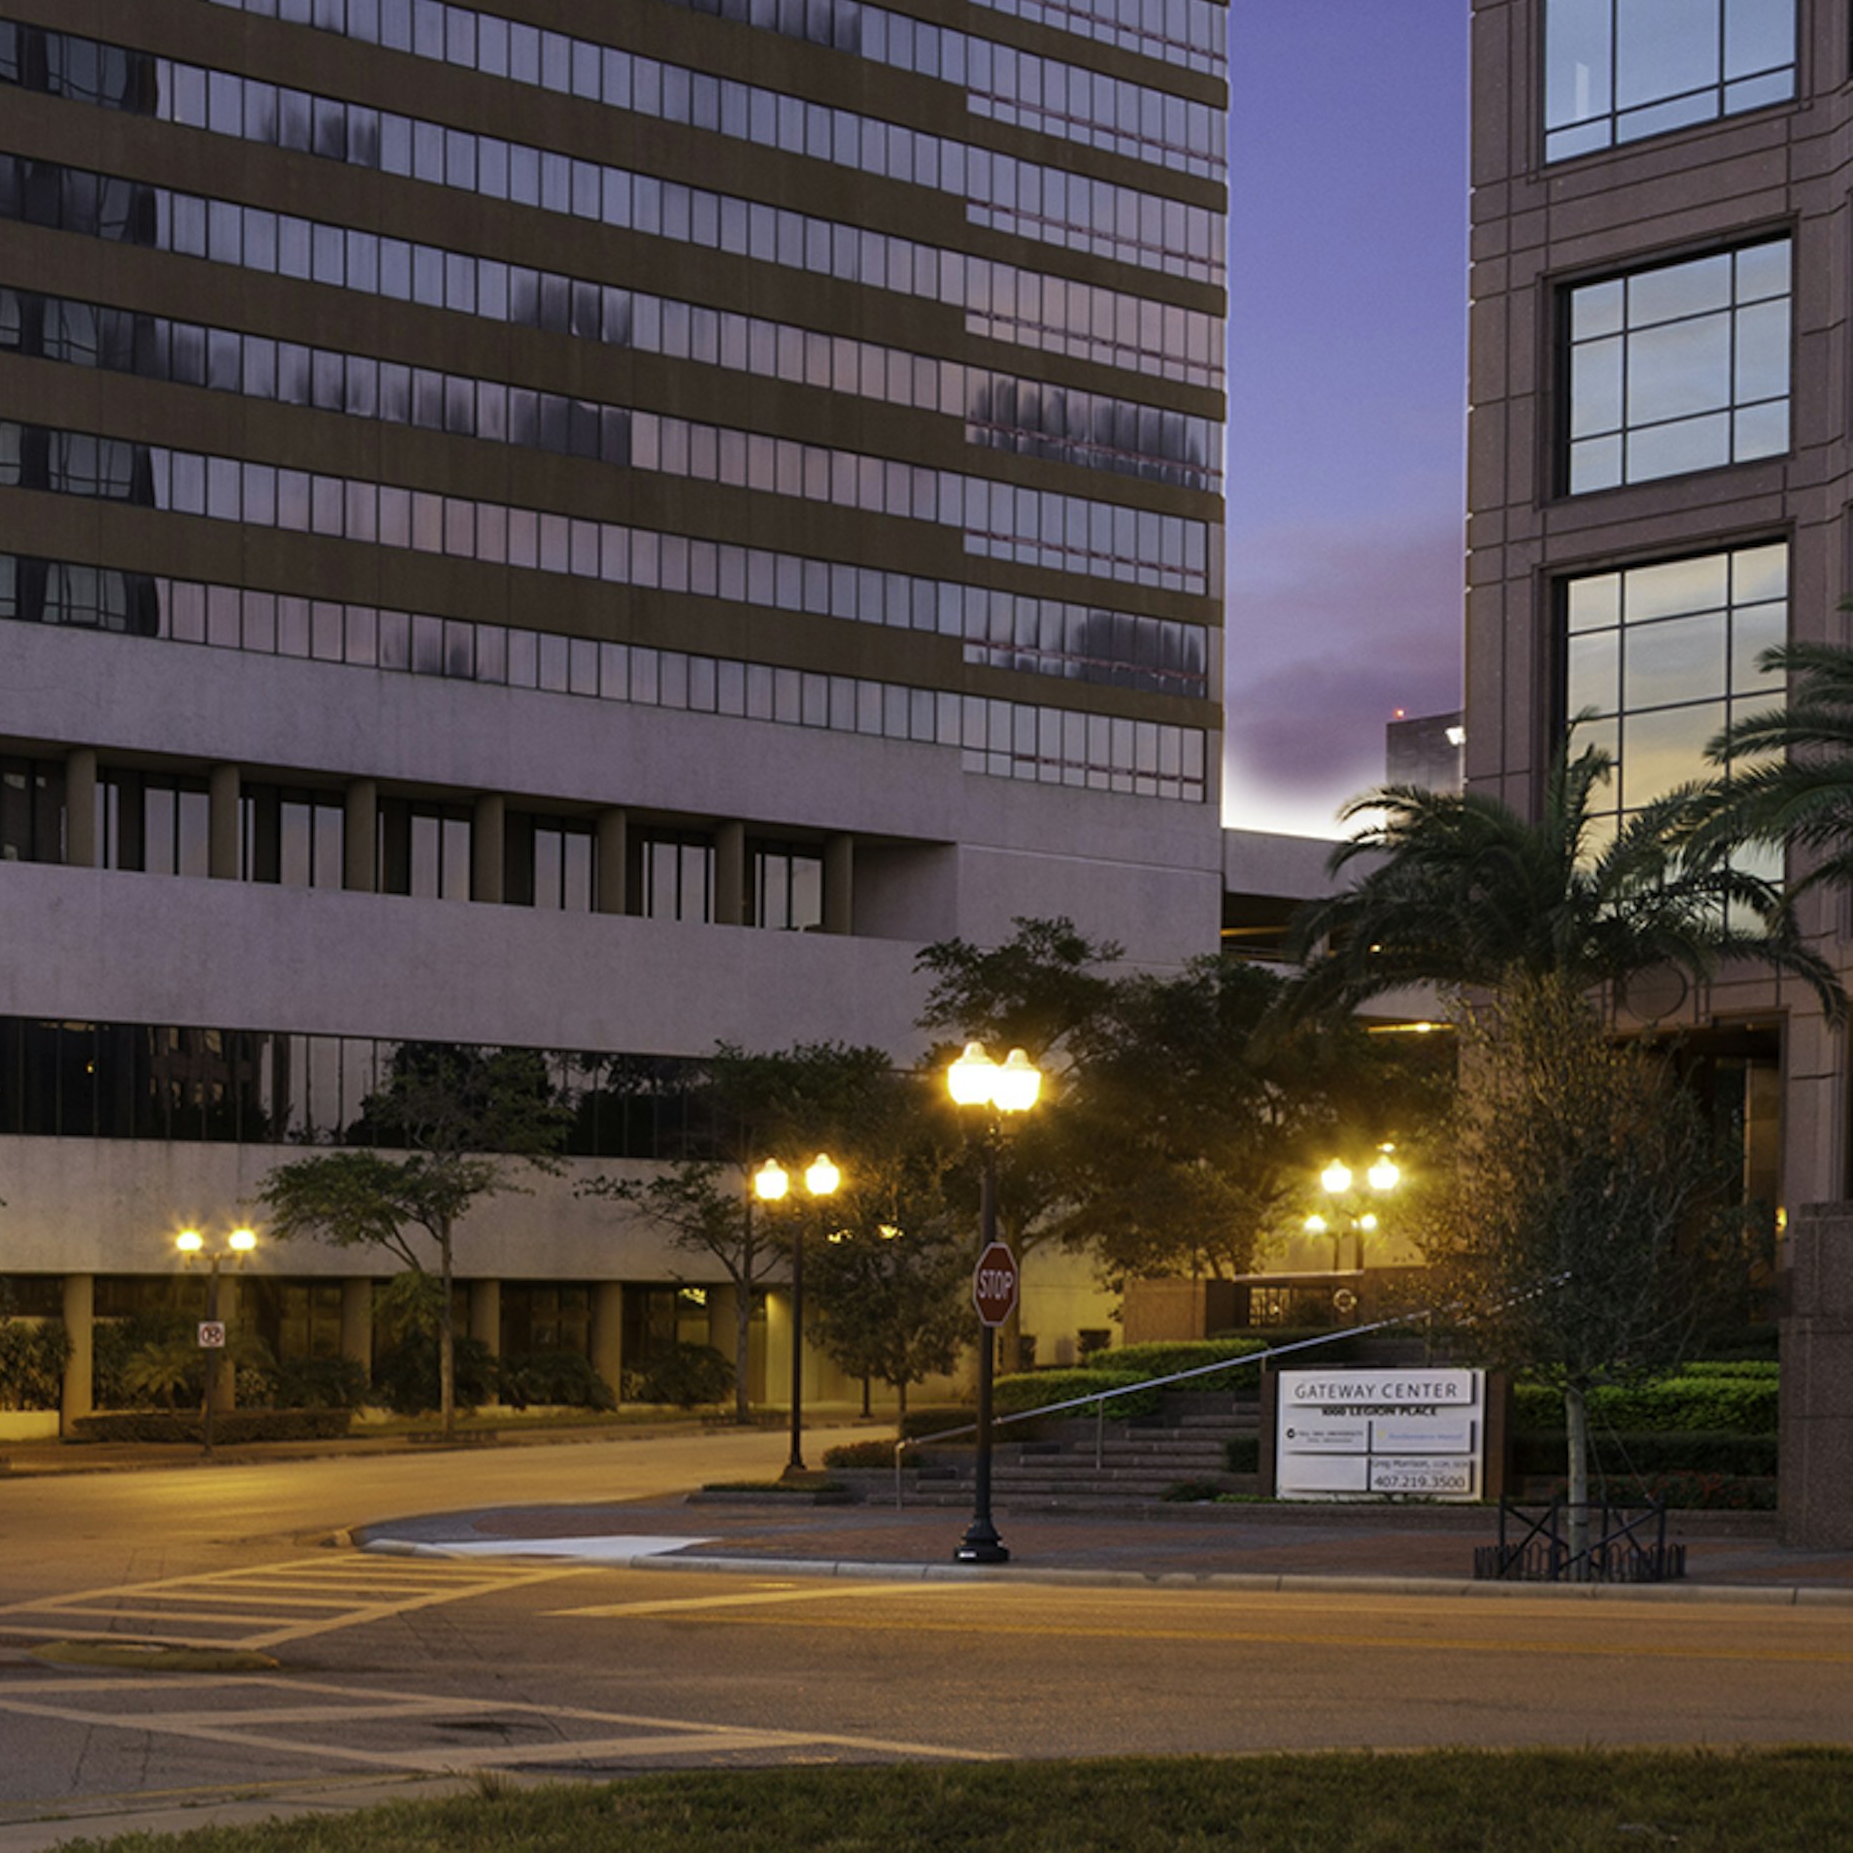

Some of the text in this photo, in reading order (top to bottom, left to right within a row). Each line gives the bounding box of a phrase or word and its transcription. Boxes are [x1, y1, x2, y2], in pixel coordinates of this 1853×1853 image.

[977, 1269, 1013, 1300] STOP
[1294, 1383, 1457, 1399] GATEWAY CENTER
[1350, 1406, 1395, 1416] LEGION
[1400, 1406, 1437, 1416] PLACE
[1374, 1475, 1466, 1488] 407.219.3500
